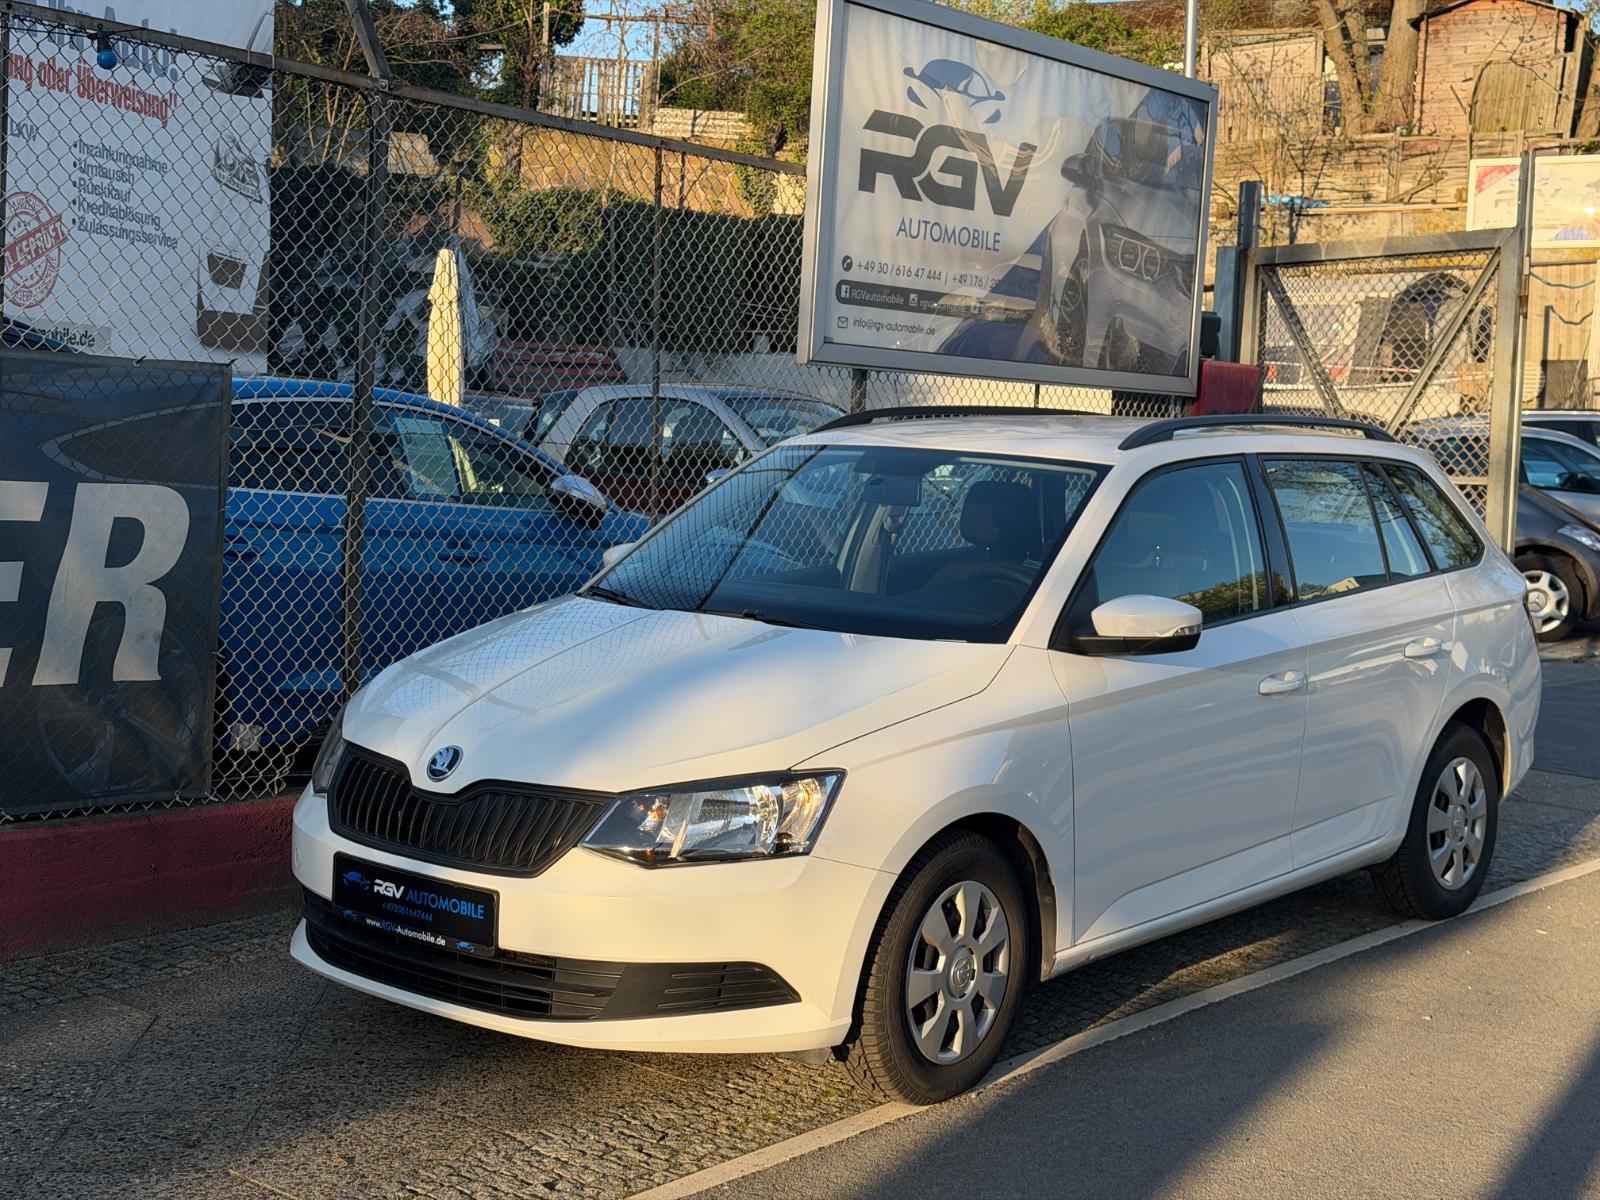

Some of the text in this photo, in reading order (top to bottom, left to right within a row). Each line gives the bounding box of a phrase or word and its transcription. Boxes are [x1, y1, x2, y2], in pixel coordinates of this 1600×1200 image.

[38, 58, 72, 94] oder
[858, 109, 1038, 218] RGV
[896, 217, 1001, 252] AUTOMOBILE
[857, 260, 876, 272] +49
[877, 262, 889, 275] 30
[895, 265, 912, 278] 616
[914, 267, 925, 279] 47
[926, 269, 942, 281] 444
[952, 273, 967, 286] +49
[970, 274, 983, 288] 176
[851, 288, 905, 305] RGVautomobile
[853, 316, 936, 336] info@rgv-automobile.de
[373, 878, 485, 920] RGV AUTOMOBILE
[365, 917, 446, 946] www.RGV-Automobile.de
